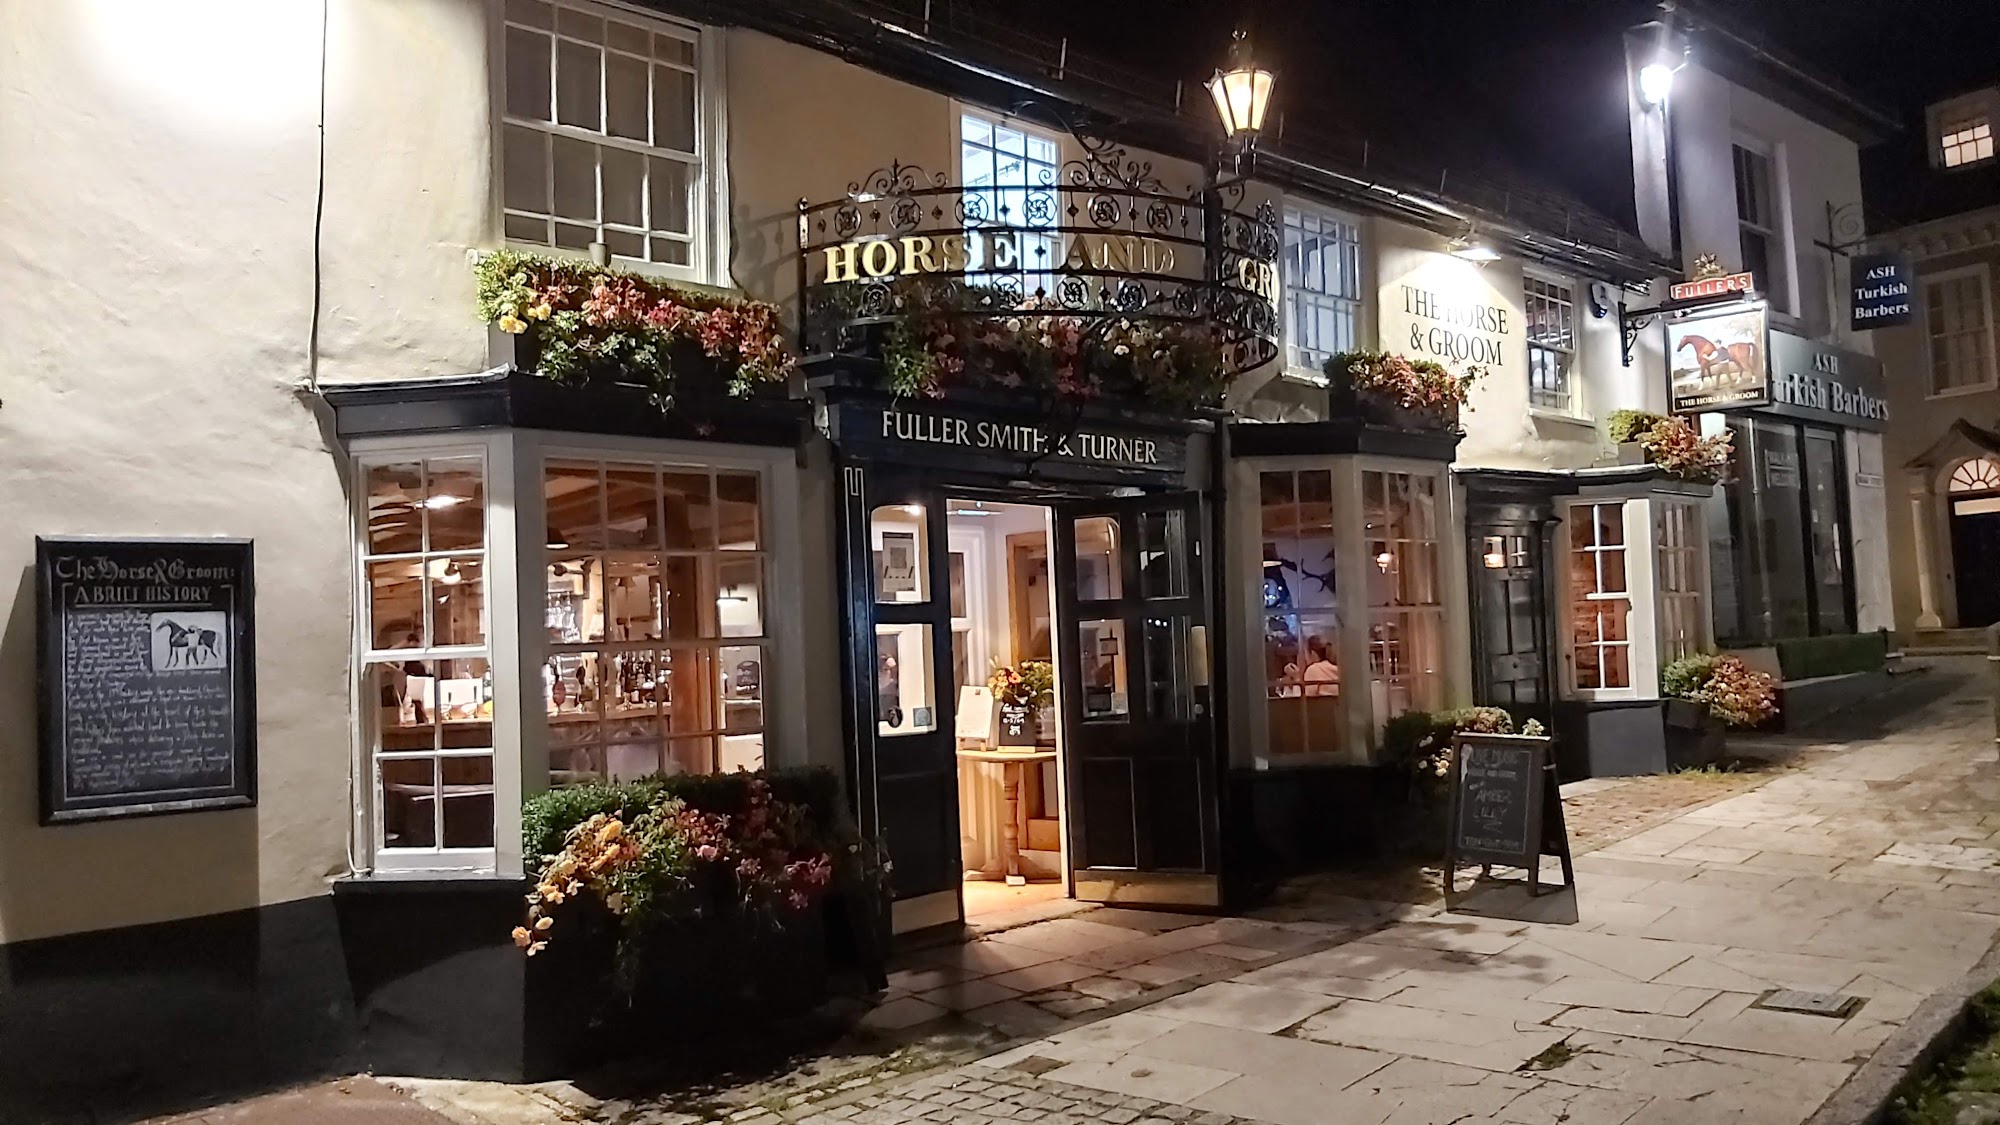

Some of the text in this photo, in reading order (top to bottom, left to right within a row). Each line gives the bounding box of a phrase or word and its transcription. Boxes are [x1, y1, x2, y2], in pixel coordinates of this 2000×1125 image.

[823, 231, 1017, 284] HORSE
[1062, 232, 1175, 275] AND
[1866, 265, 1896, 280] ASH
[1674, 276, 1748, 299] FULLER'S
[1855, 282, 1908, 300] Turkish
[1401, 284, 1509, 335] THE HORSE
[1855, 303, 1909, 319] Barbers
[1410, 322, 1503, 367] & GROOM
[1814, 353, 1838, 375] ASH
[1679, 398, 1696, 407] THE
[1696, 395, 1720, 405] HORSE
[1729, 391, 1759, 401] GROOM
[1831, 381, 1889, 421] Barbers
[882, 411, 971, 446] FULLER
[976, 422, 1049, 454] SMITH
[1078, 433, 1158, 464] TURNER
[56, 555, 95, 581] The
[75, 585, 89, 603] A
[145, 585, 213, 602] HISTORY
